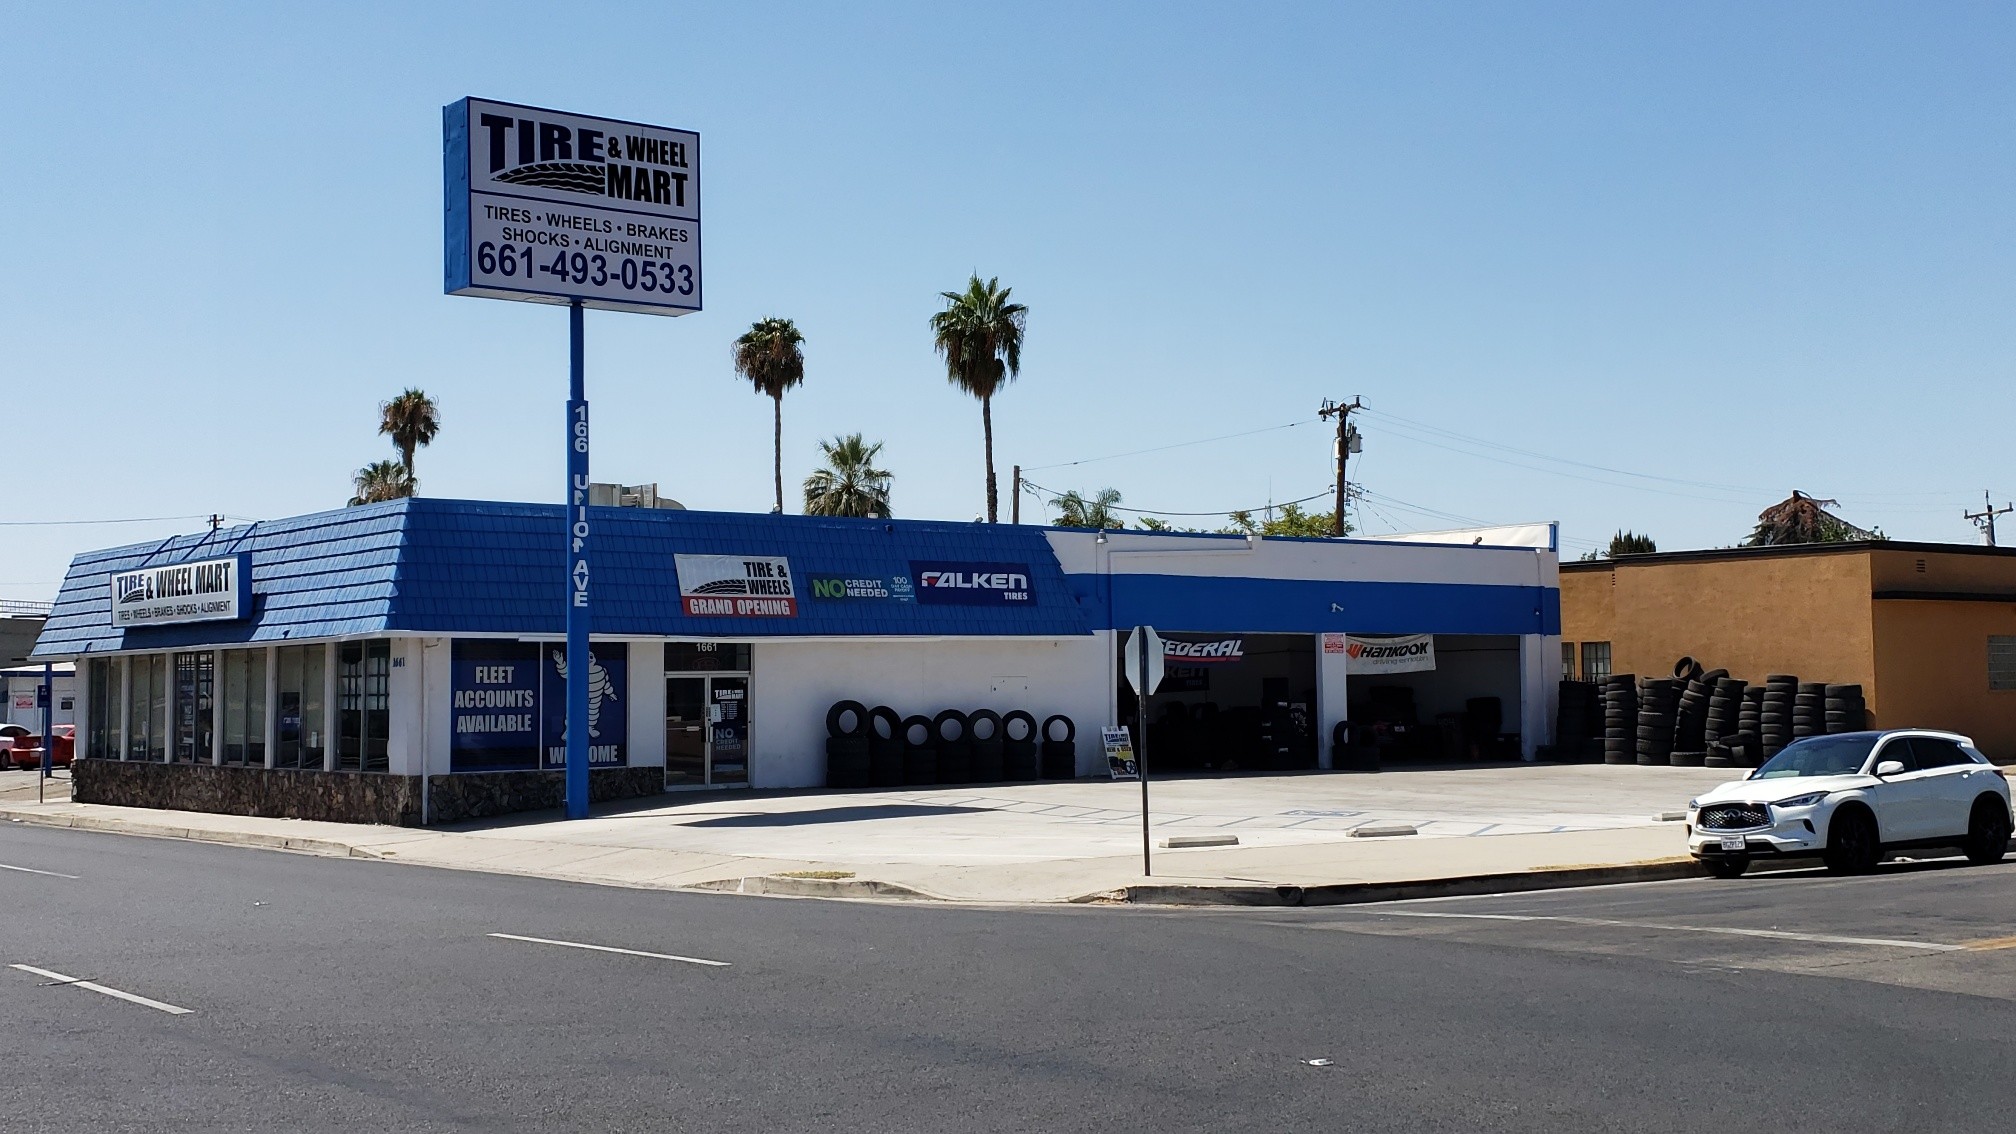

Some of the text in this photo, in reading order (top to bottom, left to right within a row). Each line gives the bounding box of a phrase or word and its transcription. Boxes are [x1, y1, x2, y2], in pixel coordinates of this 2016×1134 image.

[481, 113, 689, 173] TIRE & WHEEL
[608, 162, 689, 207] MART
[484, 205, 688, 242] TIRES WHEELS BRAKES
[502, 227, 673, 259] SHOCKS ALIGNMENT
[477, 241, 694, 296] 661-493-0533
[743, 562, 787, 578] TIRE &
[116, 562, 231, 600] TIRE & WHEEL MART
[573, 559, 589, 607] AVE
[747, 579, 790, 595] WHEELS
[813, 579, 846, 598] NO
[845, 579, 882, 588] CREDIT
[893, 576, 907, 585] 100
[846, 588, 889, 598] NEEDED
[1004, 592, 1028, 600] TIRES
[118, 600, 231, 620] TIRES WHEELS BRAKES SHOCKS ALIGNMENT
[689, 599, 790, 615] GRAND OPENING
[696, 642, 717, 652] 1661
[475, 666, 514, 684] FLEET
[454, 689, 534, 708] ACCOUNTS
[456, 714, 531, 733] AVAILABLE
[716, 728, 734, 739] NO
